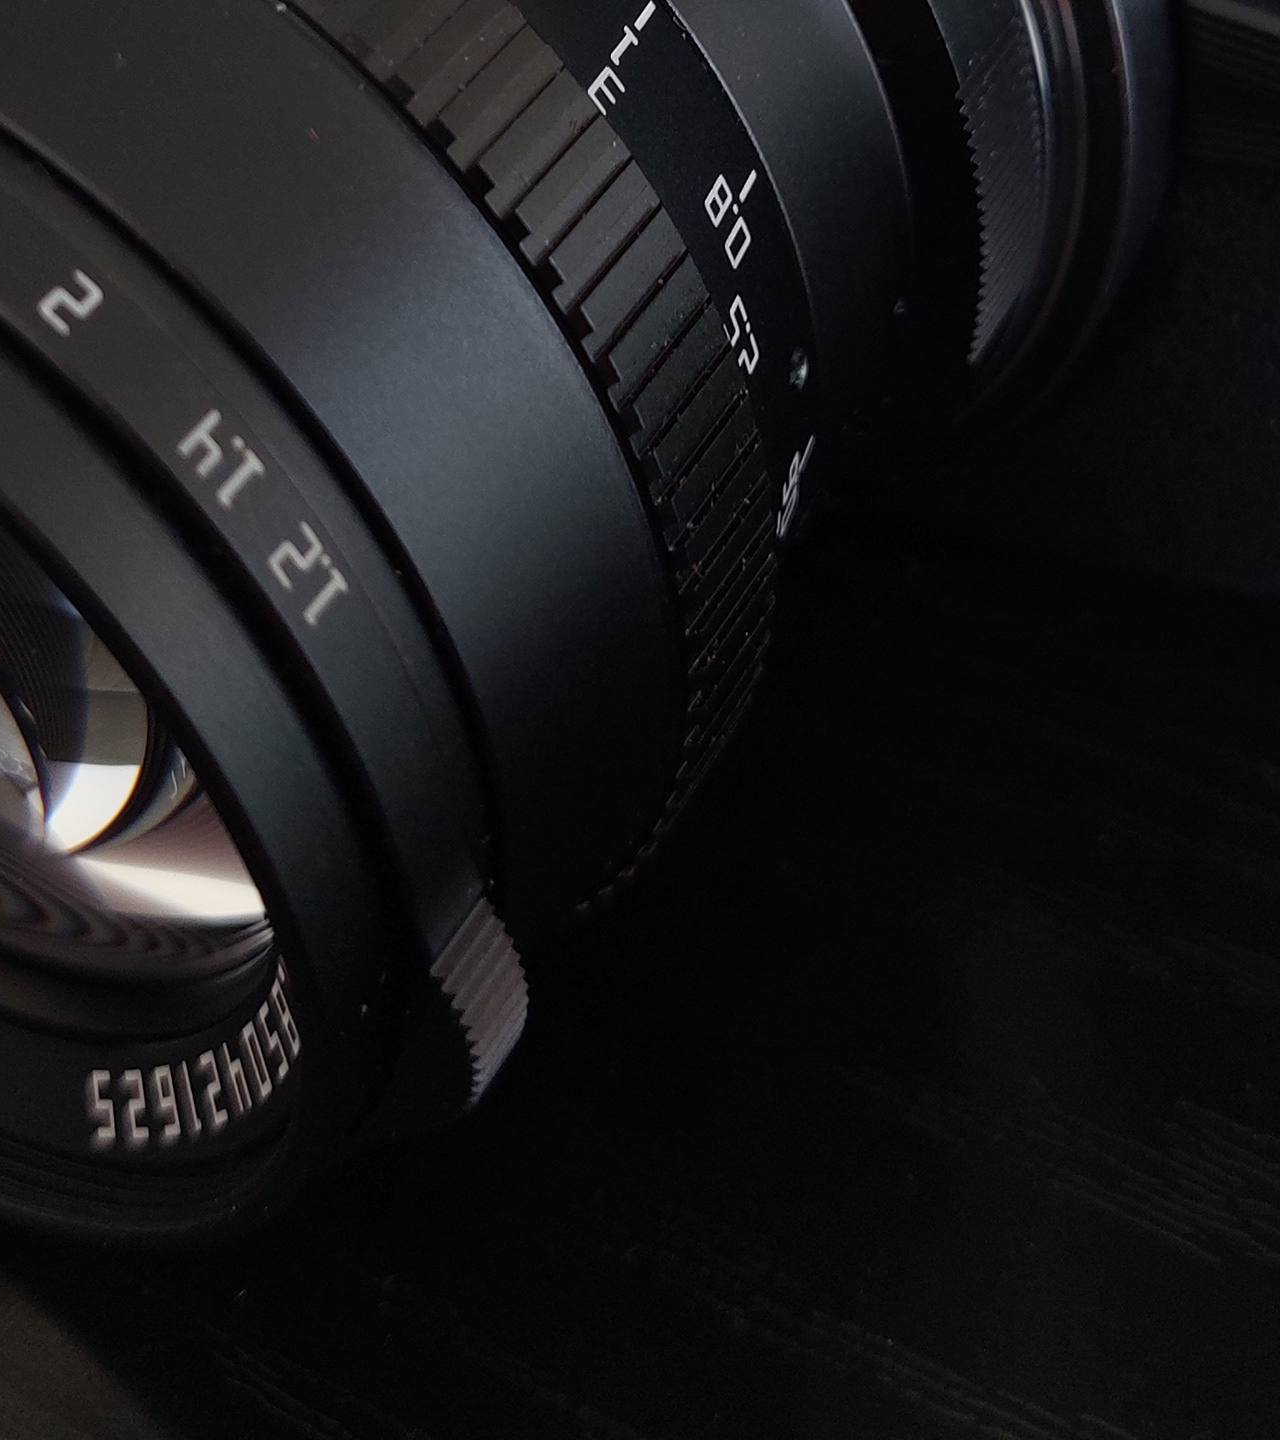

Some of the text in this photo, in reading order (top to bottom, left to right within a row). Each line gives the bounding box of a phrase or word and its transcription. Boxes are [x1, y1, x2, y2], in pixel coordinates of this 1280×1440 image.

[587, 68, 626, 116] 3
[612, 26, 638, 66] 1
[704, 173, 752, 269] 0.8
[38, 269, 104, 334] 2
[177, 408, 266, 508] 1.4
[268, 520, 349, 626] 1.2
